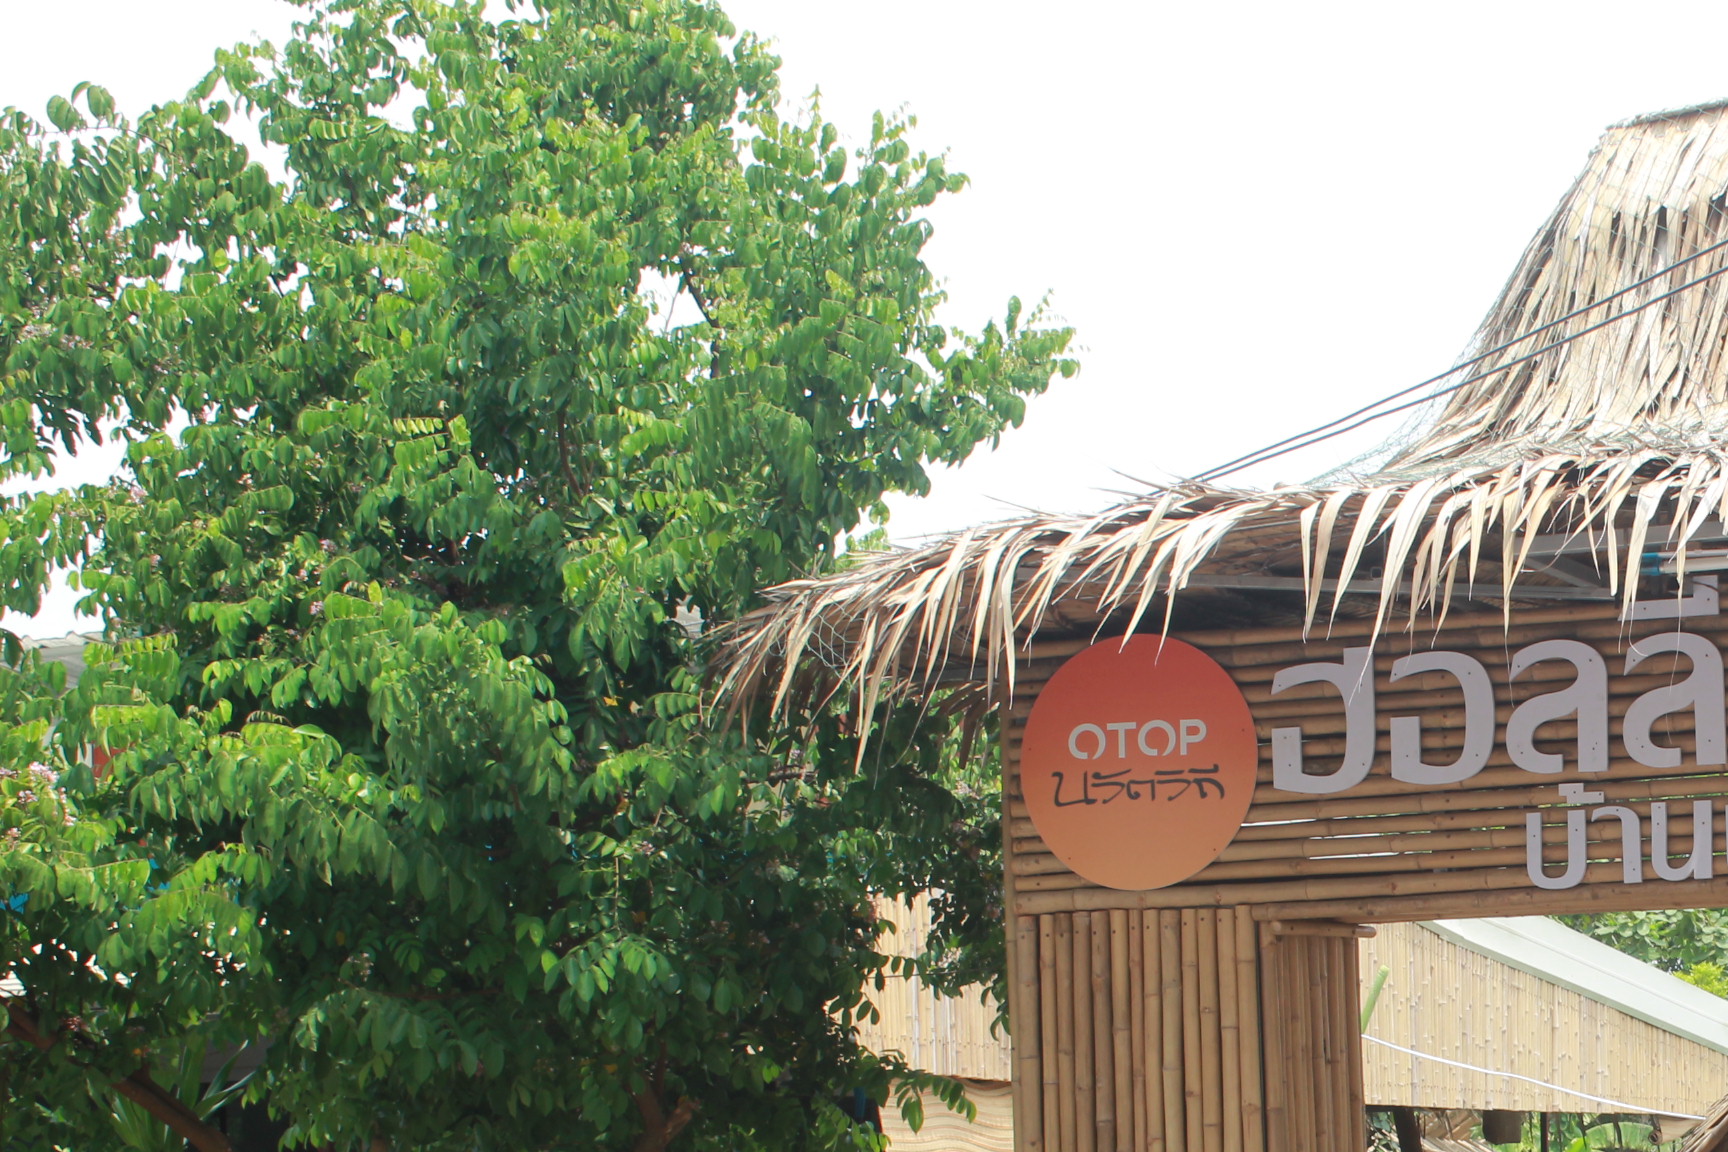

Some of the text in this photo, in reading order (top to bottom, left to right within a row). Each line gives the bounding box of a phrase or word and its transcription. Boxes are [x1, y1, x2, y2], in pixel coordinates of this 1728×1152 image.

[1068, 719, 1207, 760] OTOP
[1052, 763, 1226, 807] นวัตวิถี
